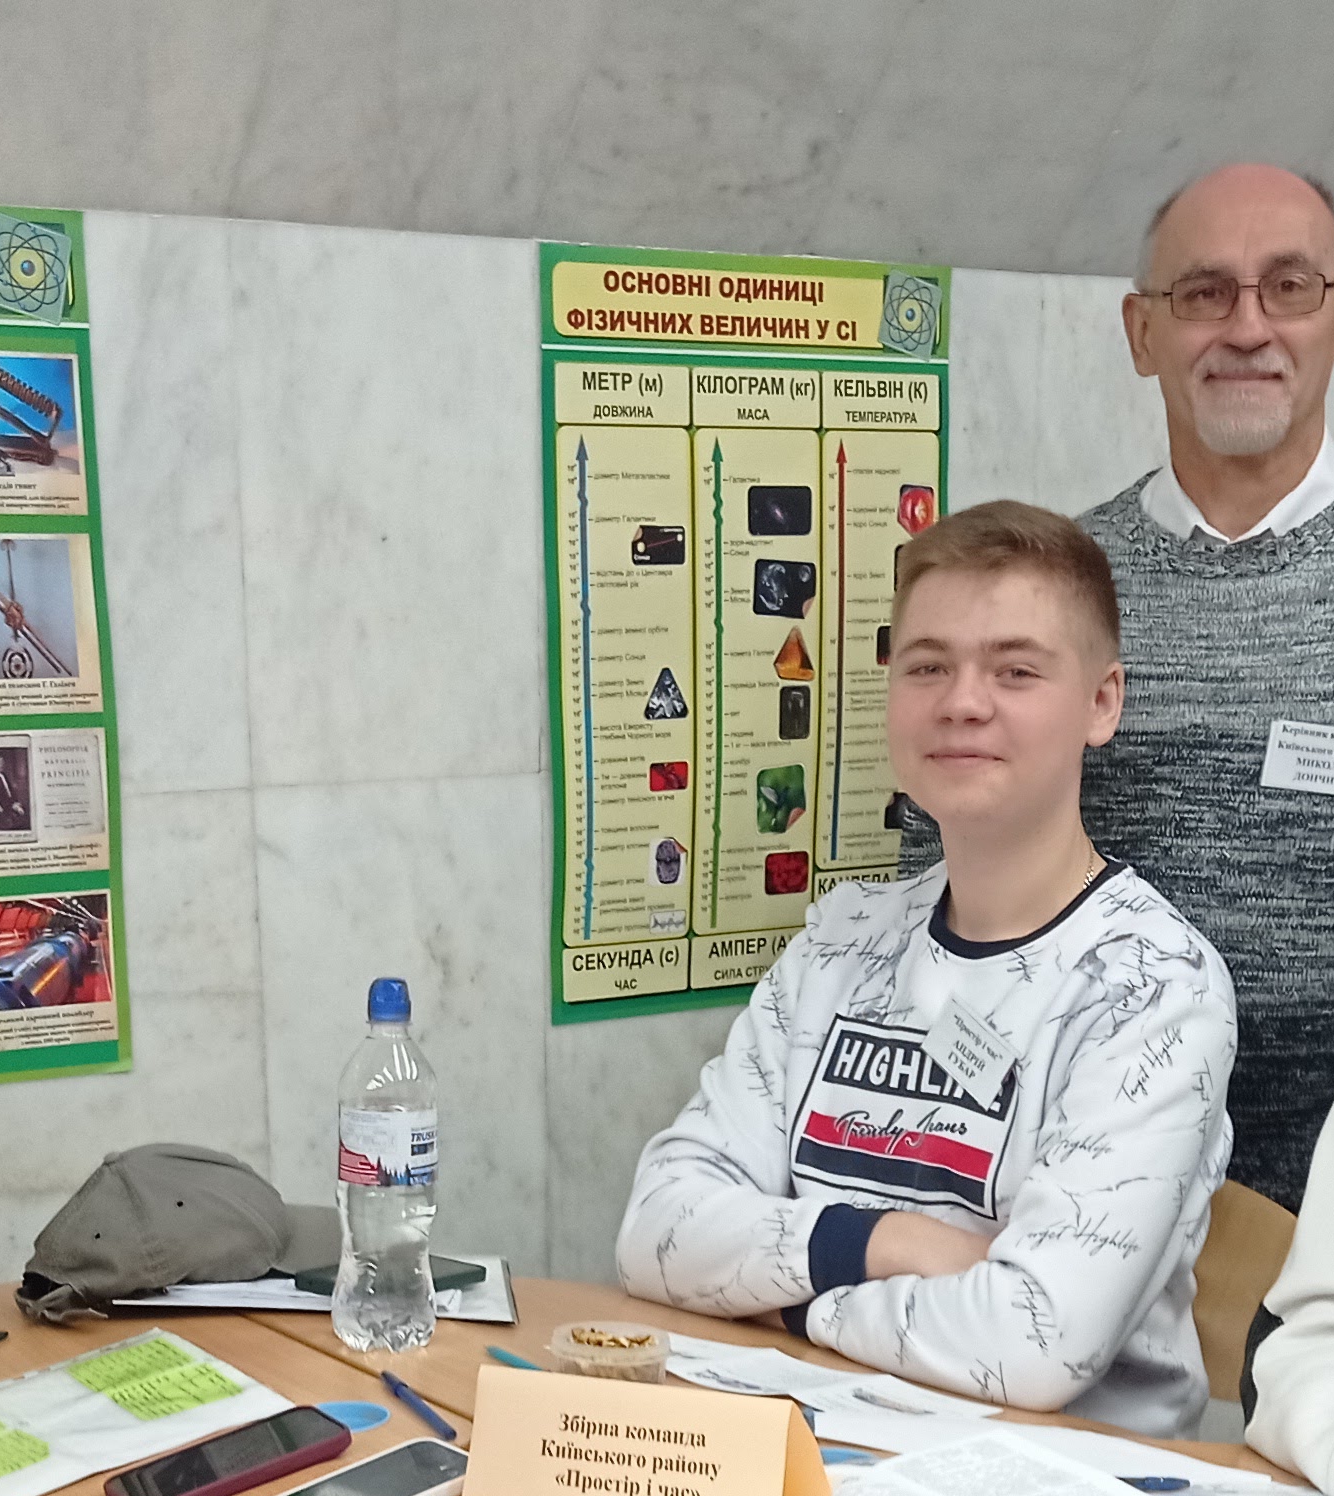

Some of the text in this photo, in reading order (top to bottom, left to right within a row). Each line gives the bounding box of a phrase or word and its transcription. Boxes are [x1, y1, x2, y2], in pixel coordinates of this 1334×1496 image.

[603, 271, 825, 305] ОСНОВНІ ОДИНИЦІ
[567, 308, 857, 341] ФІЗИЧНИХ ВЕЛИЧИН У СІ
[581, 370, 664, 396] МЕТР (м)
[696, 374, 816, 401] КІЛОГРАМ (кг)
[833, 378, 929, 404] КЕЛЬВІН (К)
[593, 404, 654, 420] ДОВЖИНА
[737, 407, 770, 422] МАСА
[845, 409, 918, 425] ТЕМПЕРАТУРА
[708, 935, 792, 958] АМПЕР (А
[572, 948, 655, 972] СЕКУНДА
[614, 978, 638, 991] ЧАС
[714, 968, 743, 980] СИЛА
[558, 1413, 706, 1449] Збірна команда
[540, 1438, 722, 1481] Київського району
